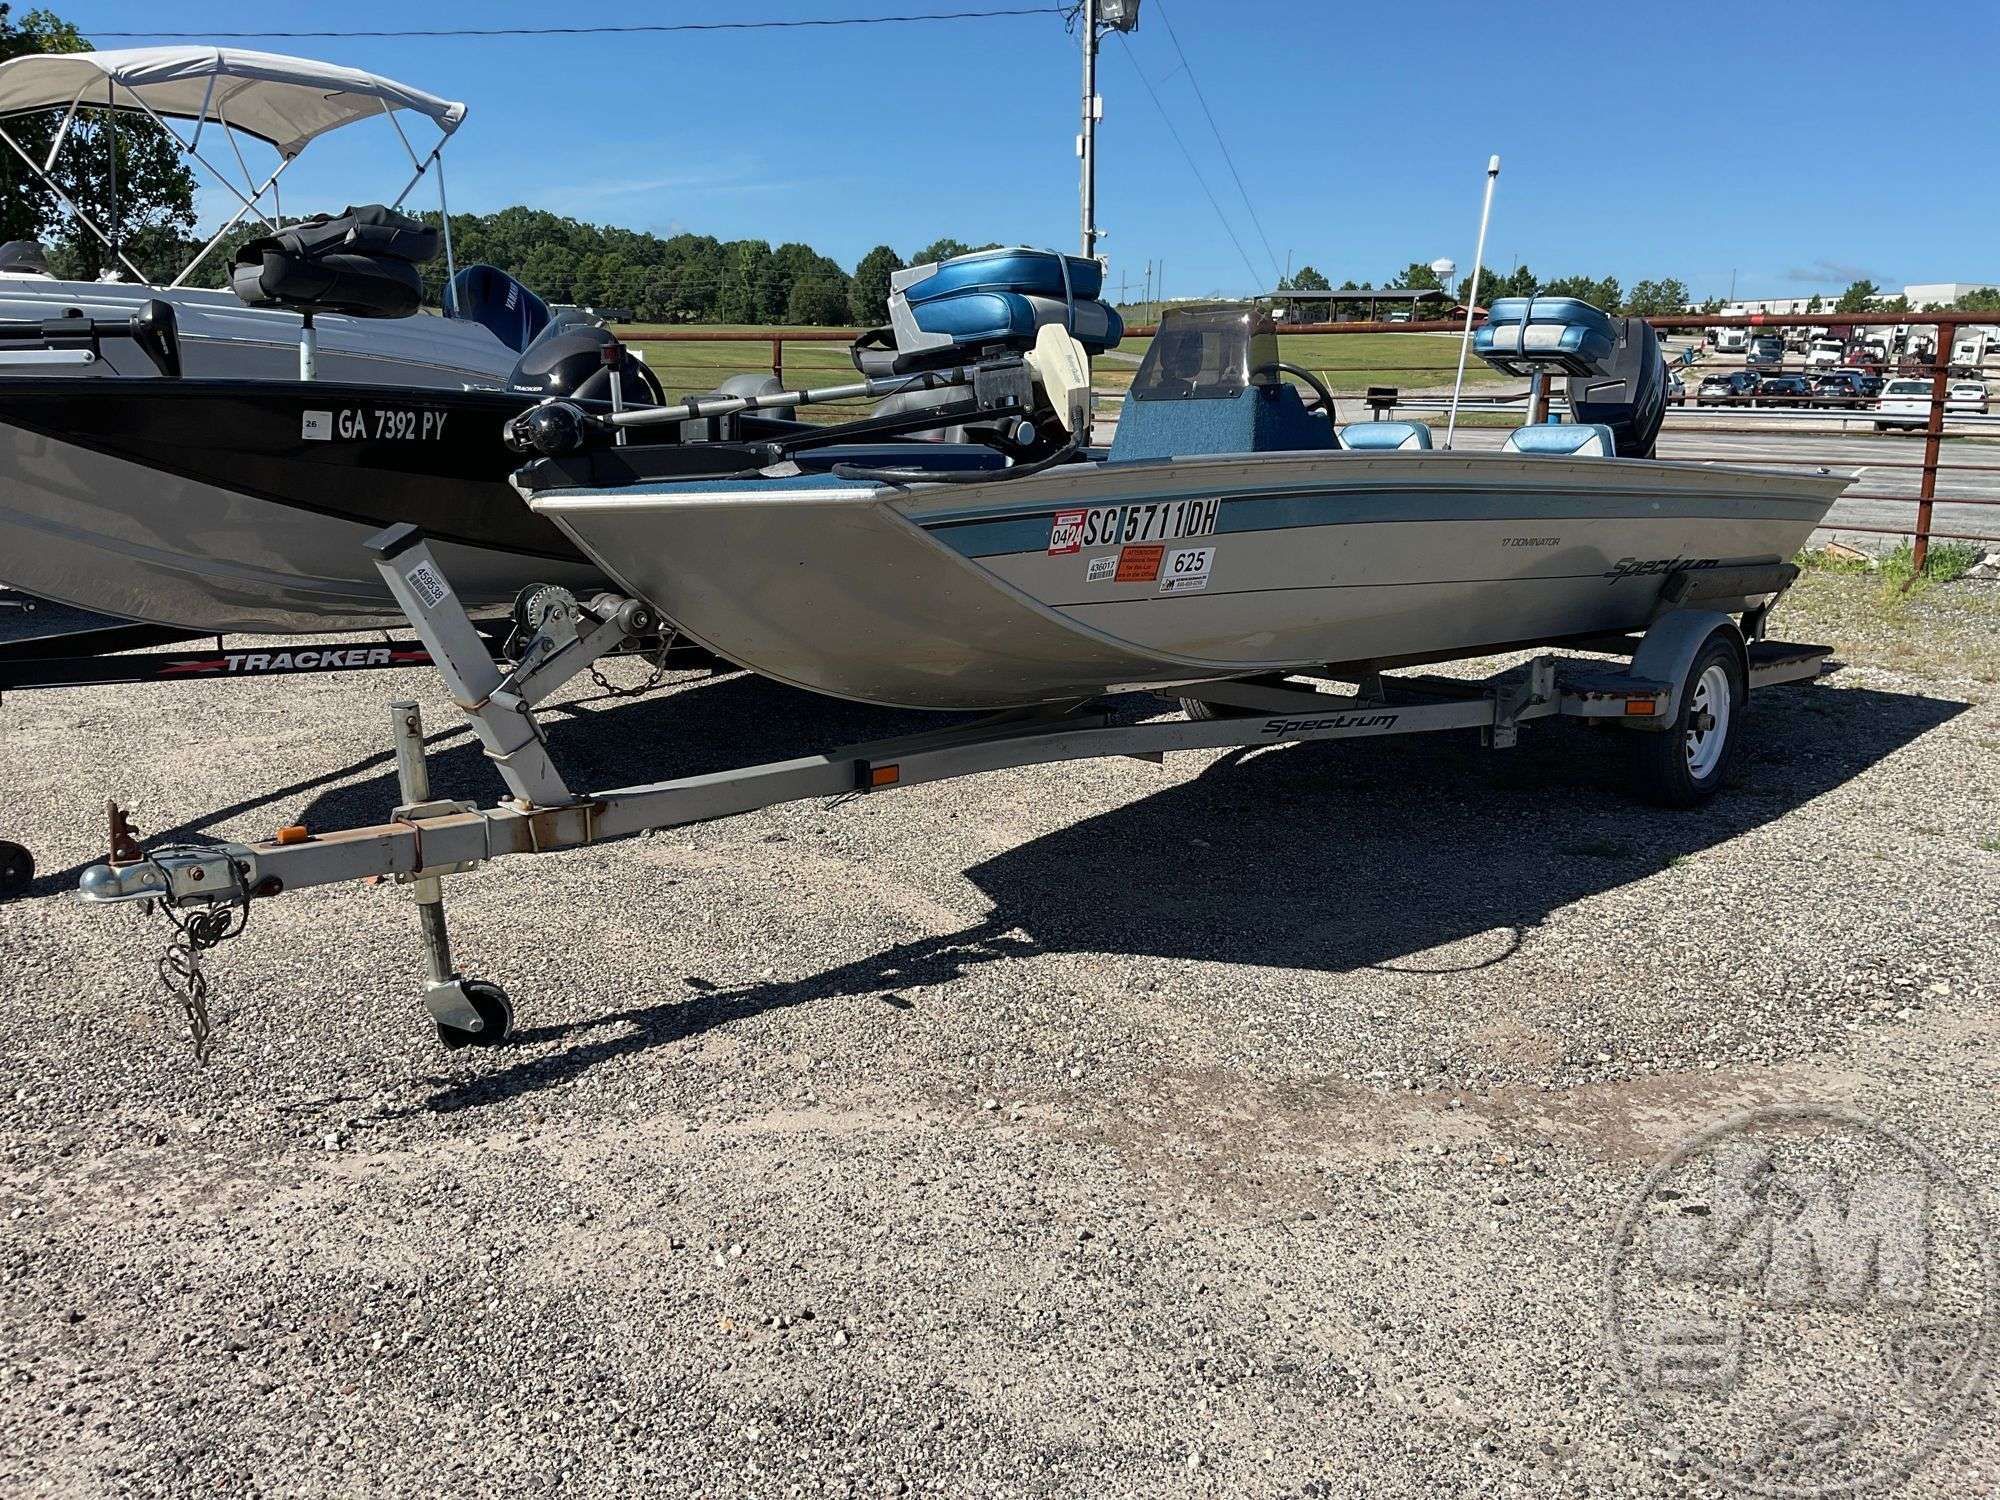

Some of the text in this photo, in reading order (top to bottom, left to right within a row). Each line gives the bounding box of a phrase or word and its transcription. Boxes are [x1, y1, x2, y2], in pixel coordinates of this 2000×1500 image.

[338, 409, 448, 440] GA 7392 PY
[1083, 499, 1219, 545] SC 5711 DH
[1511, 537, 1560, 546] DOMINATOR
[1090, 561, 1115, 573] 436017
[1174, 551, 1206, 573] 625
[1604, 554, 1720, 586] Spectrum
[417, 569, 443, 599] 459538
[225, 649, 391, 671] TRACKER
[1261, 715, 1399, 737] Spectrum
